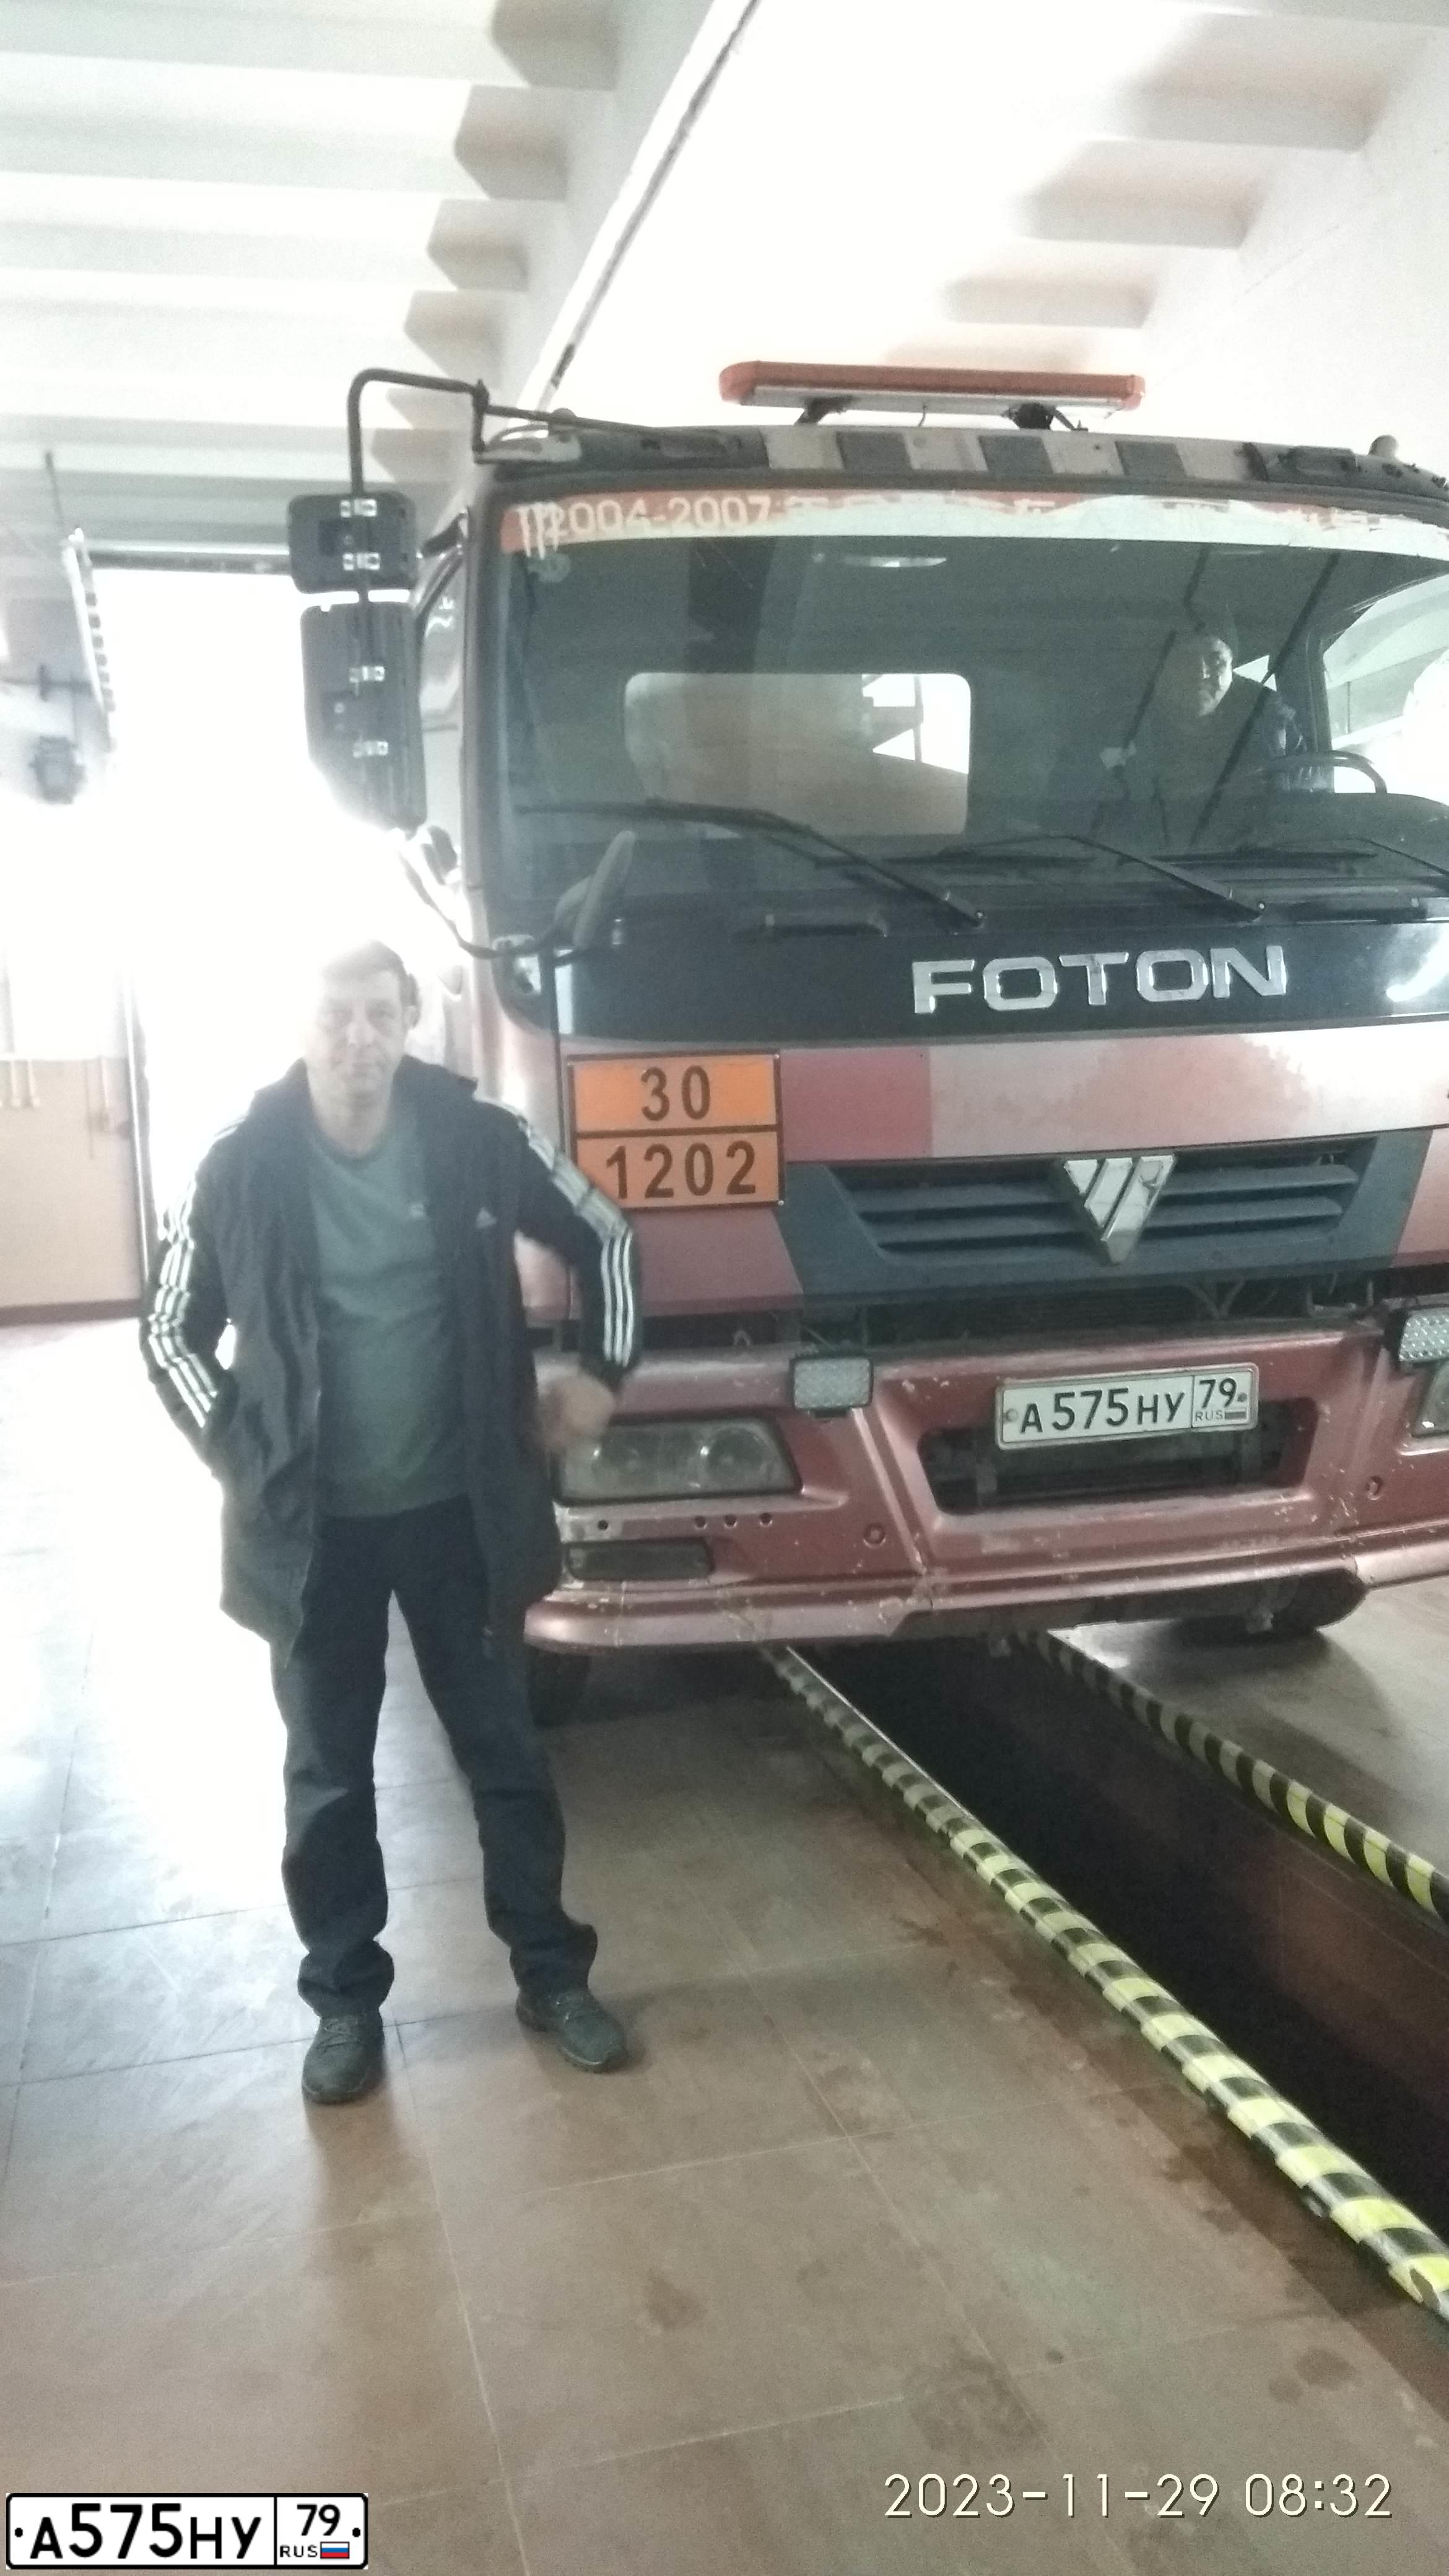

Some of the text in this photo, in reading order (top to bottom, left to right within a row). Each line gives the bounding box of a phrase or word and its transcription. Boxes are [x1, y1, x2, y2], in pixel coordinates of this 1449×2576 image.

[912, 945, 1287, 1014] FOTON
[640, 1064, 711, 1121] 30
[606, 1140, 757, 1200] 1202
[1194, 1409, 1224, 1422] RUS
[1199, 1377, 1238, 1409] 79
